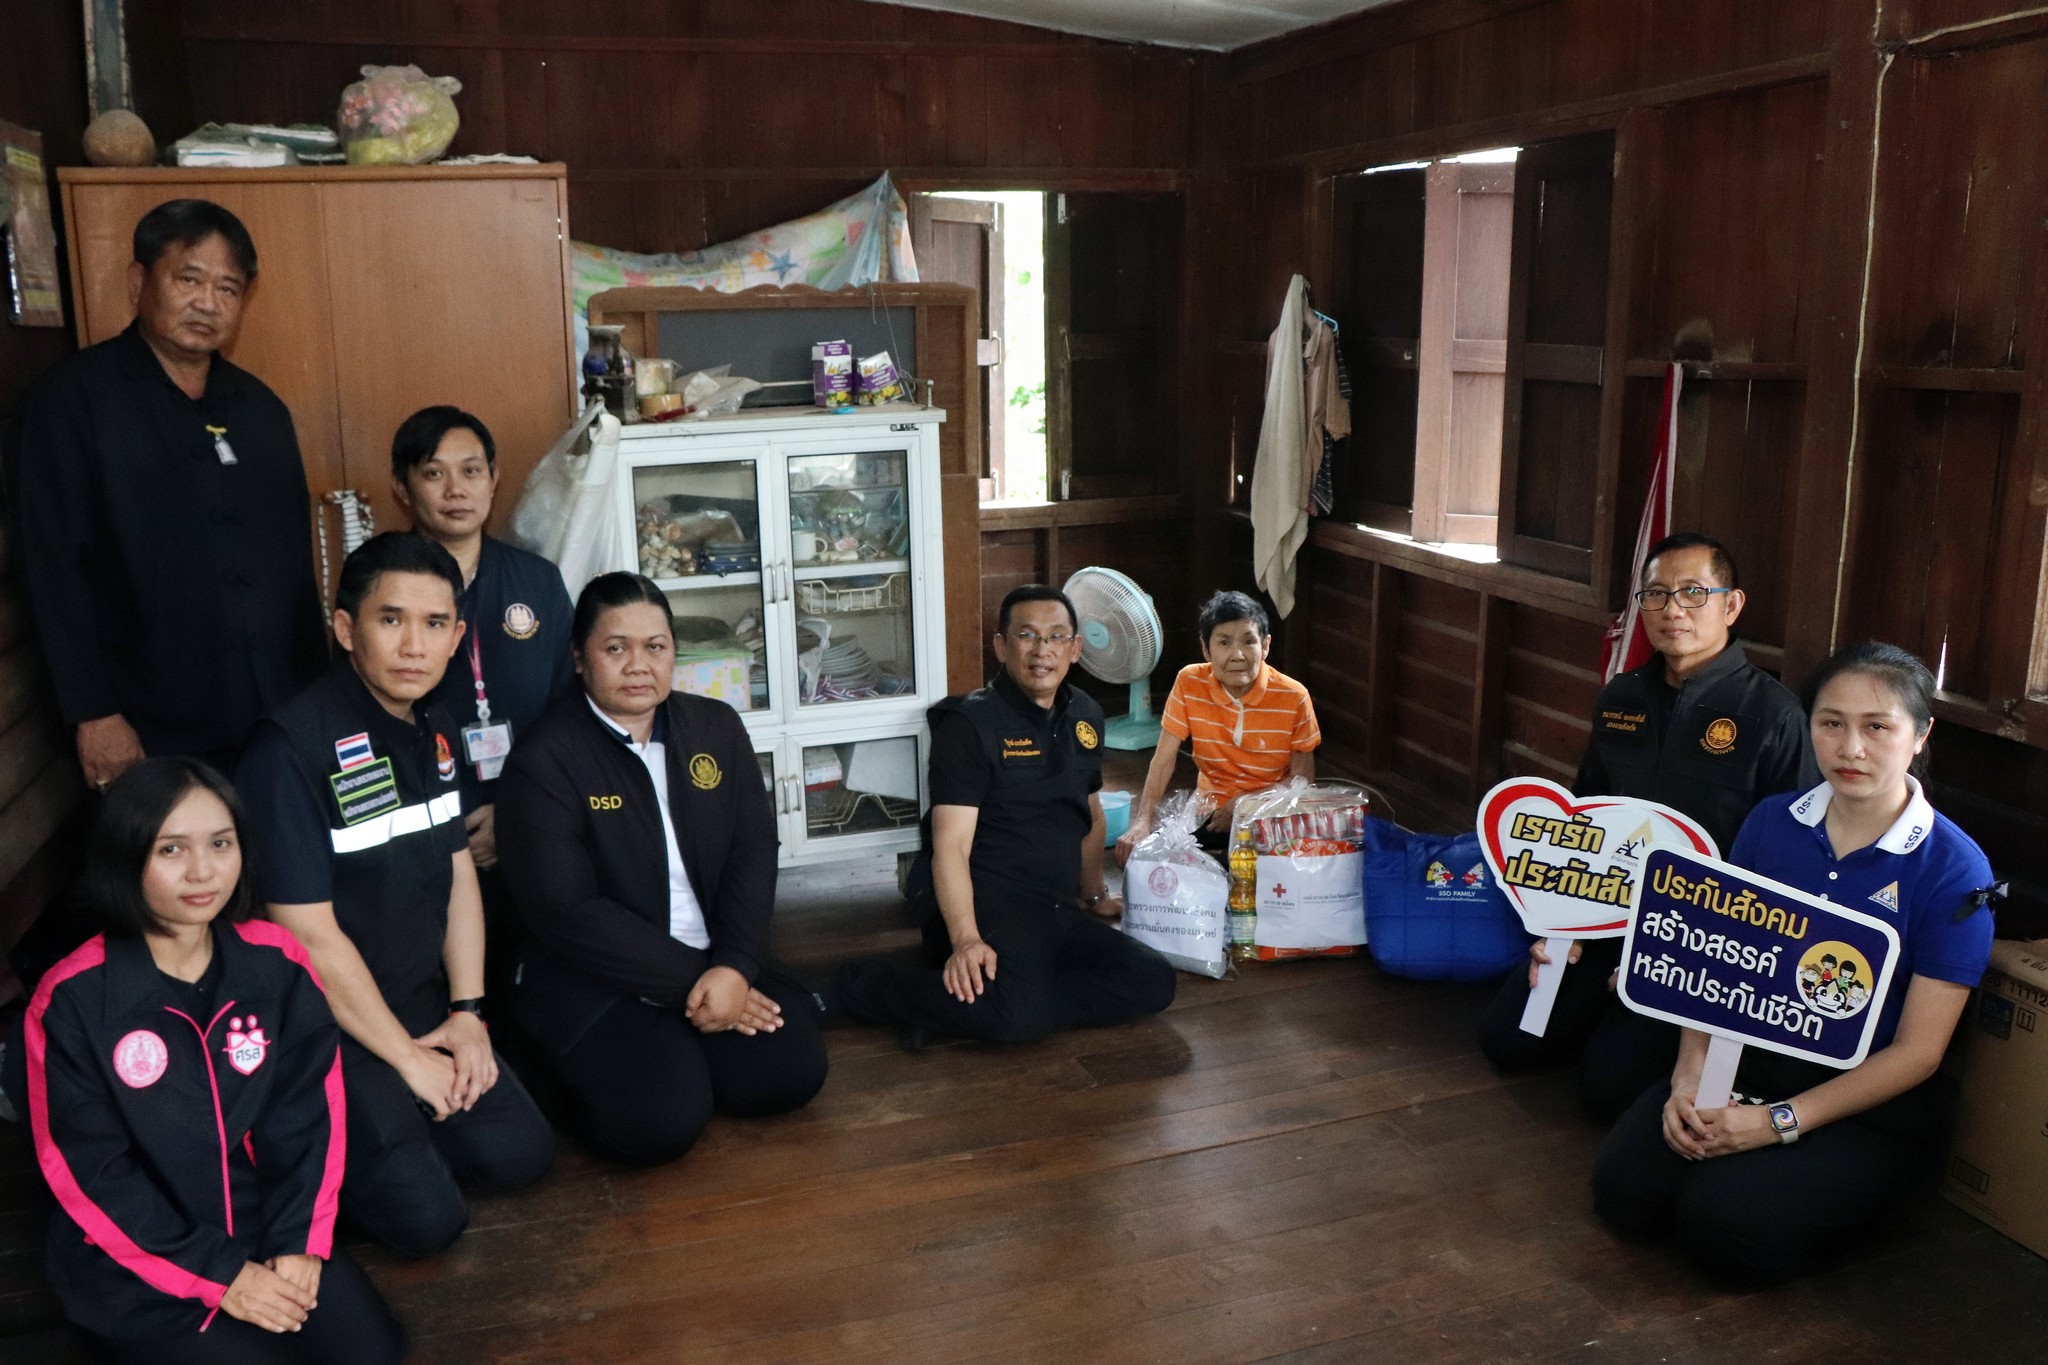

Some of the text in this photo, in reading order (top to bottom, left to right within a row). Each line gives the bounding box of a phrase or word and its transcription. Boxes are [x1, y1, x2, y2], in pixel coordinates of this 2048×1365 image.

[589, 795, 623, 810] DSD
[1510, 812, 1606, 854] เรารัก
[1904, 825, 1923, 850] SSO
[1453, 890, 1477, 898] FAMILY
[1652, 864, 1809, 940] ประกันสังคม
[1641, 909, 1783, 978] สร้างสรรค์
[1633, 951, 1824, 1041] หลักประกันชีวิต
[2010, 982, 2048, 1008] 11112
